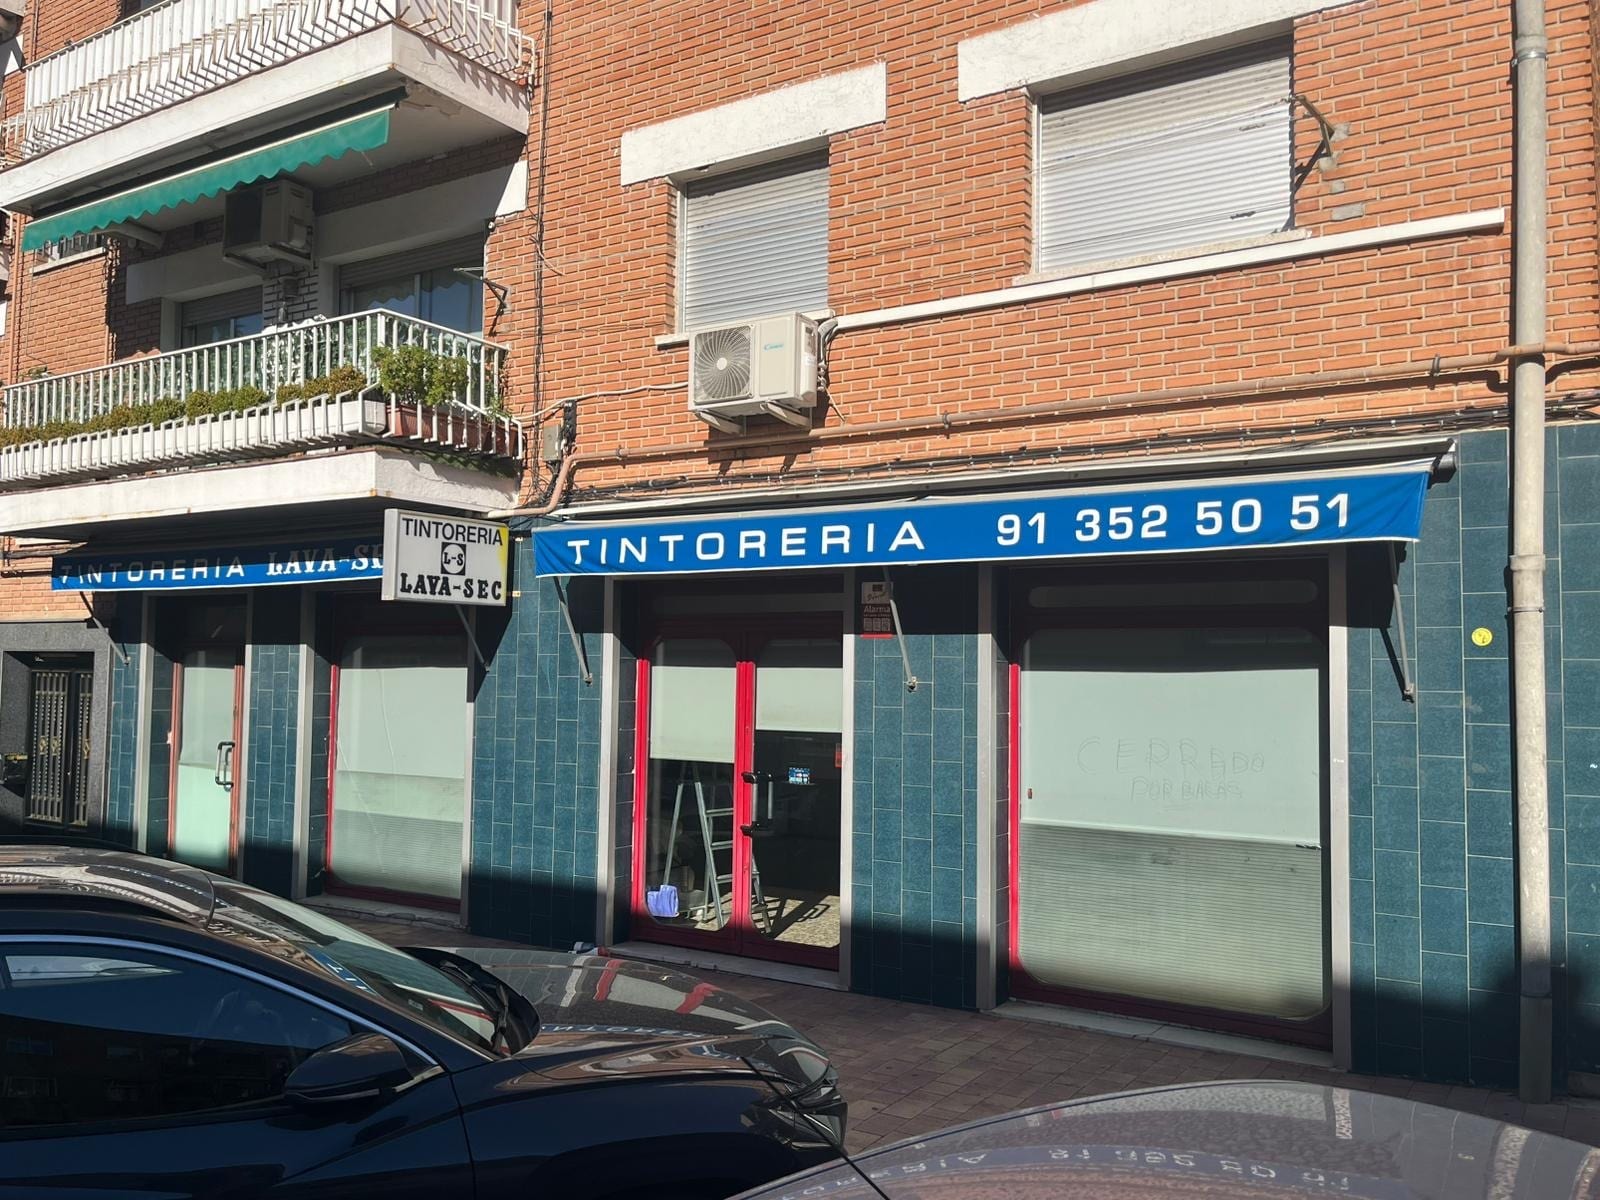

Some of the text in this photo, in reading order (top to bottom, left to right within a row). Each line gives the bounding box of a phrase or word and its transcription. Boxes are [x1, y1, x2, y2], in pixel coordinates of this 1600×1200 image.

[401, 517, 503, 546] TINTORERIA
[567, 493, 1350, 565] TINTORERIA 91 352 50 51
[60, 556, 245, 584] TINTORERIA
[443, 552, 464, 566] L-S
[400, 572, 502, 600] LAVA-SEC
[1077, 736, 1266, 779] CERRADO
